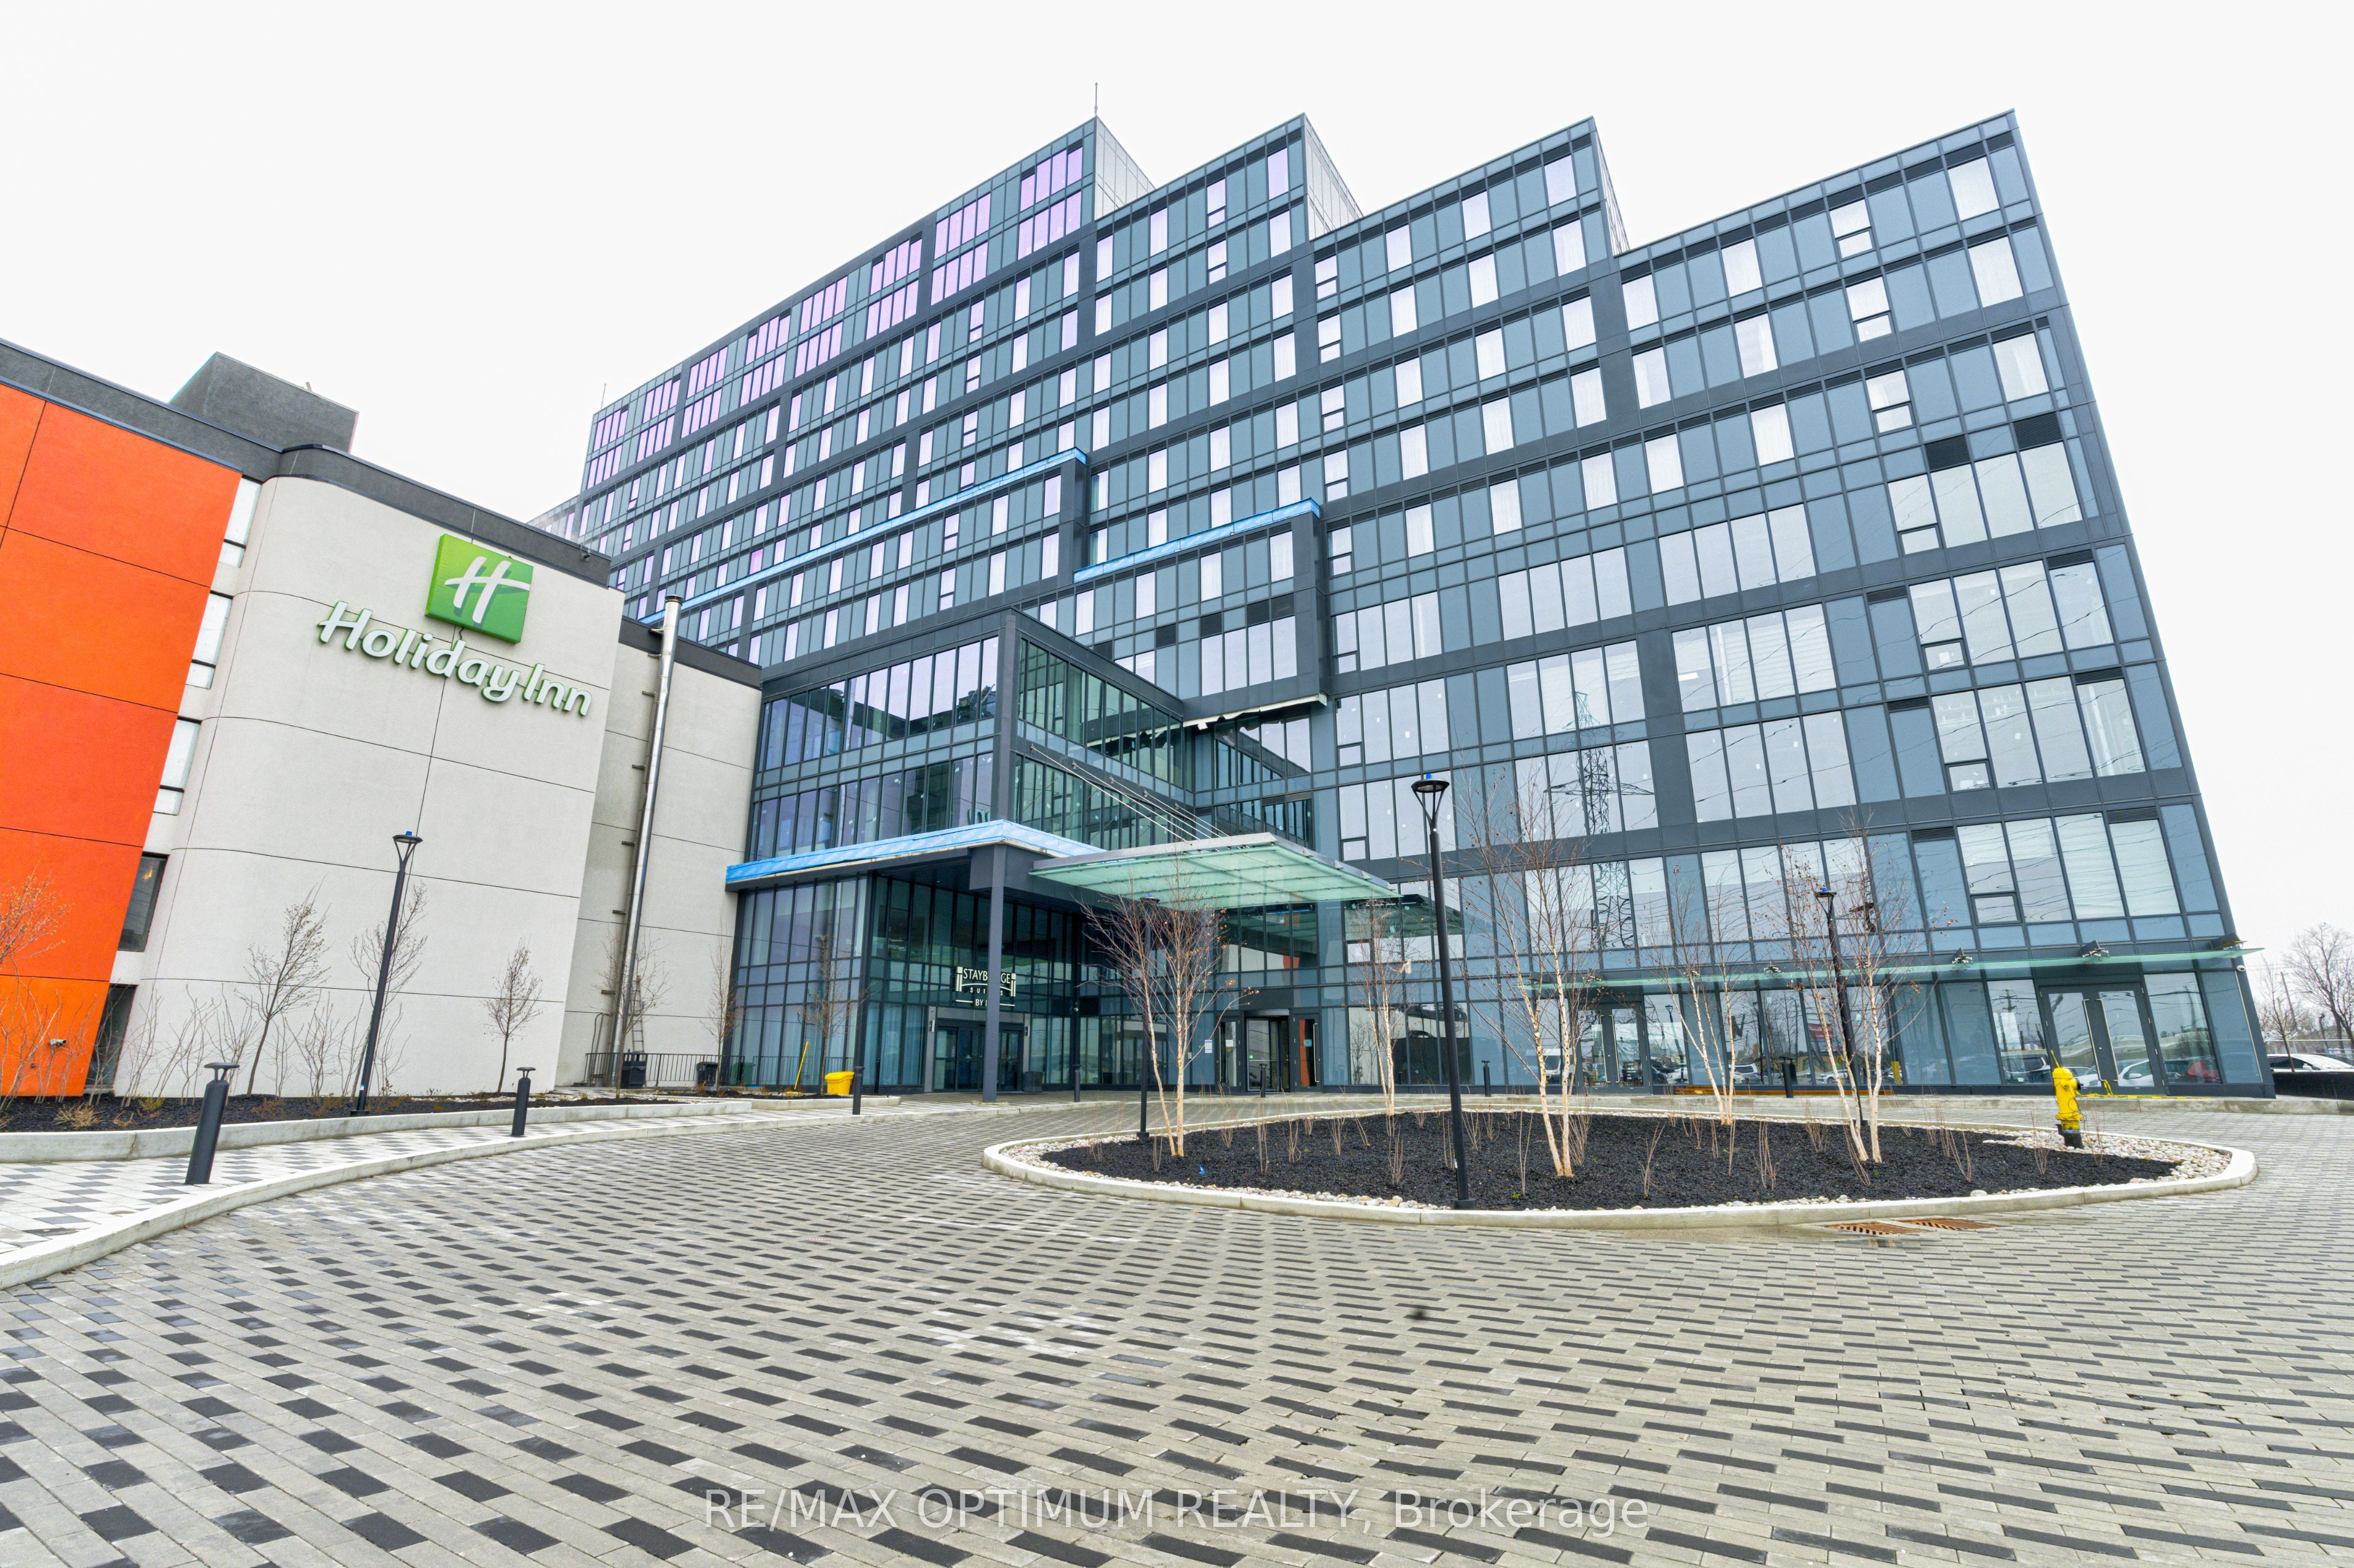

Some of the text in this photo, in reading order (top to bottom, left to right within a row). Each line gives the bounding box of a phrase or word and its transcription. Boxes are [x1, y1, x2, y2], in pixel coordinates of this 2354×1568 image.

[317, 600, 592, 717] Holiday Inn
[963, 969, 1010, 983] STAYBGE
